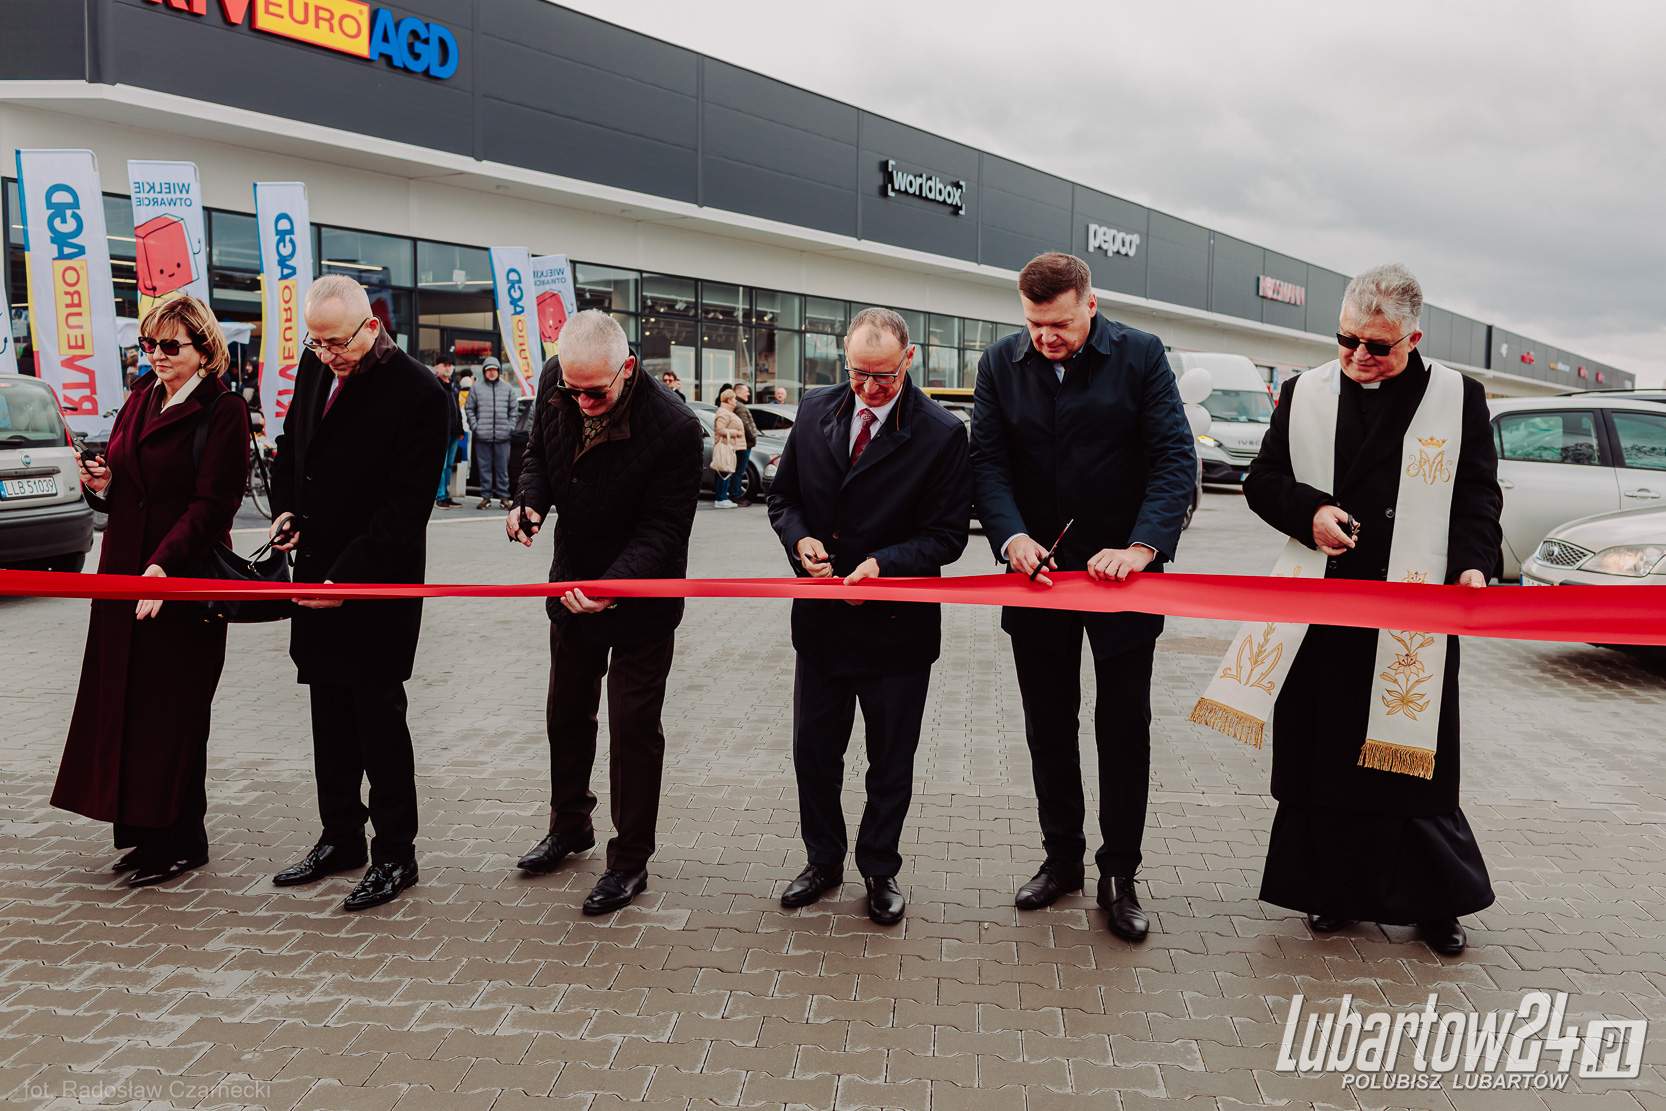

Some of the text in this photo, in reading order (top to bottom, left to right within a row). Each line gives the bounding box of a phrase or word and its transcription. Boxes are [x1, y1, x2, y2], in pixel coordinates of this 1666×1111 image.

[263, 0, 363, 39] EURO
[370, 7, 460, 80] AGD
[893, 170, 962, 207] worldbox
[1088, 223, 1137, 257] pepco
